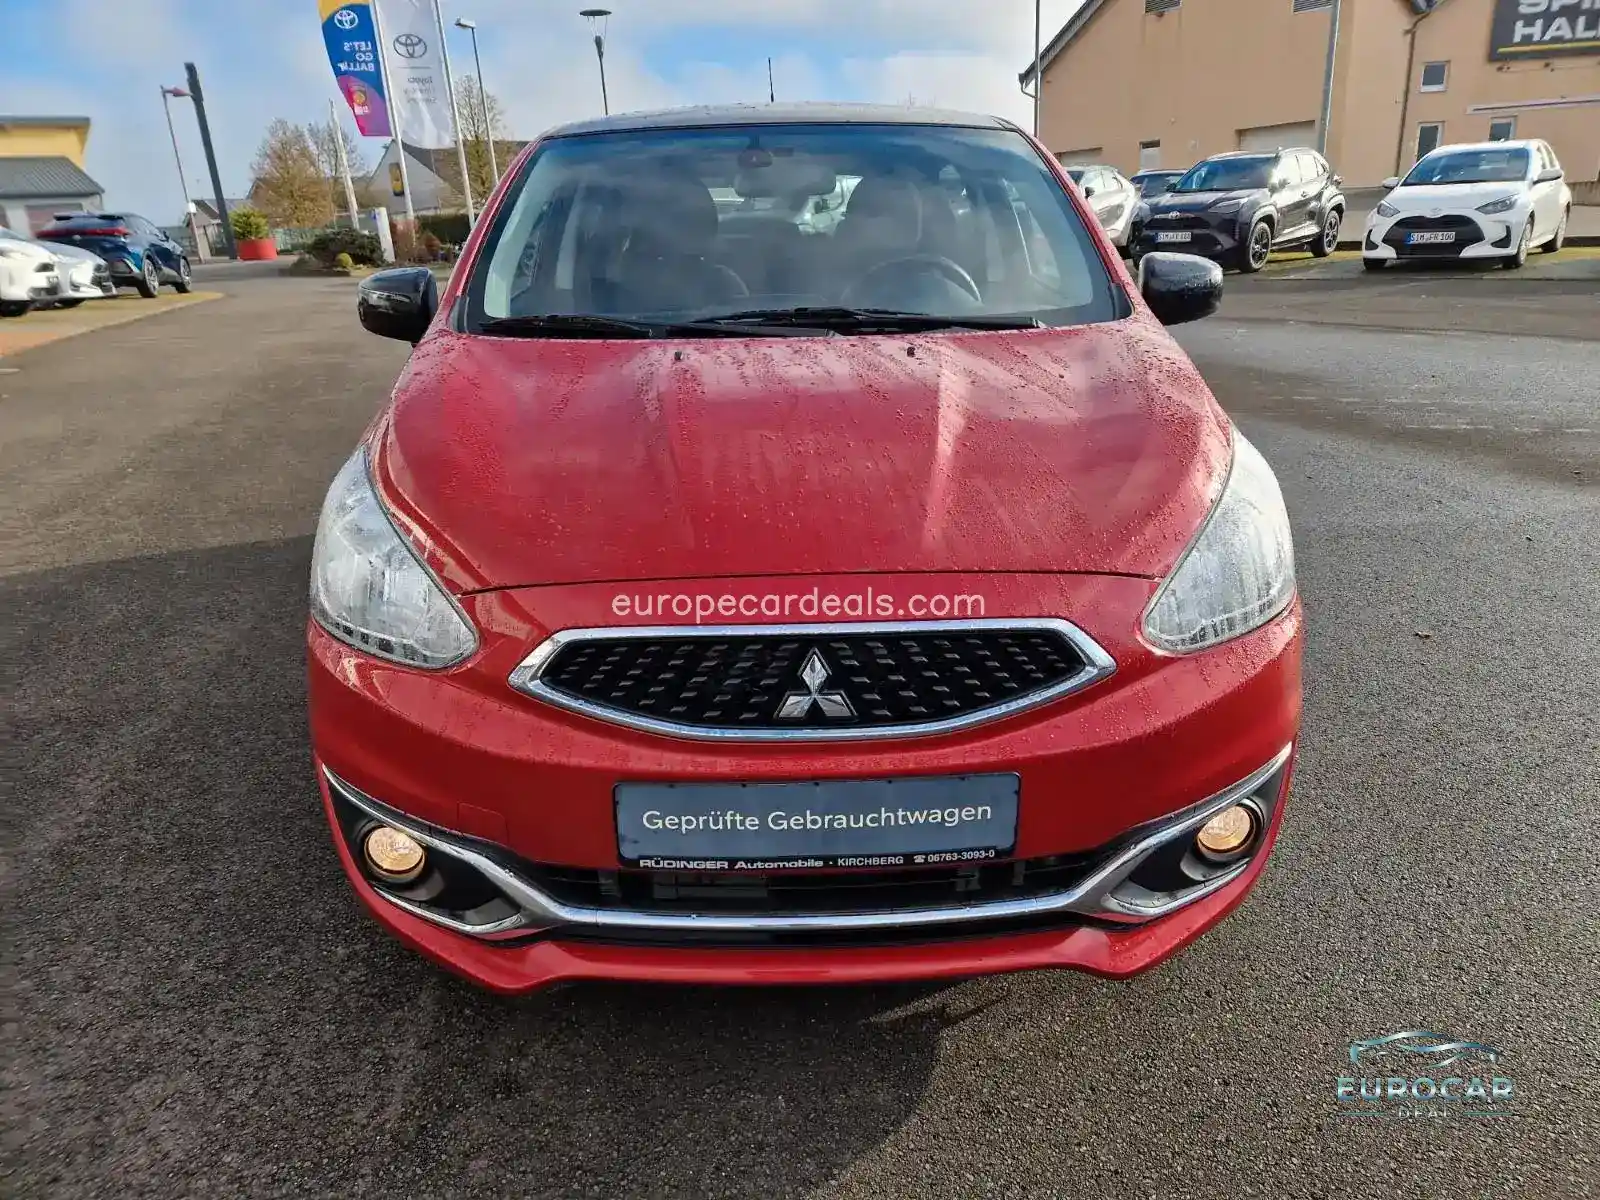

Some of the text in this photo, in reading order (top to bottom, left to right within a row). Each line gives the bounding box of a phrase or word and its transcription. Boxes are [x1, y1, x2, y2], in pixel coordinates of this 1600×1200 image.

[1512, 15, 1600, 43] HAL
[642, 805, 991, 835] Geprüfte Gebrauchtwagen
[639, 849, 995, 870] RÜDINGER Automobile KIRCHBERG 06763-3093-0
